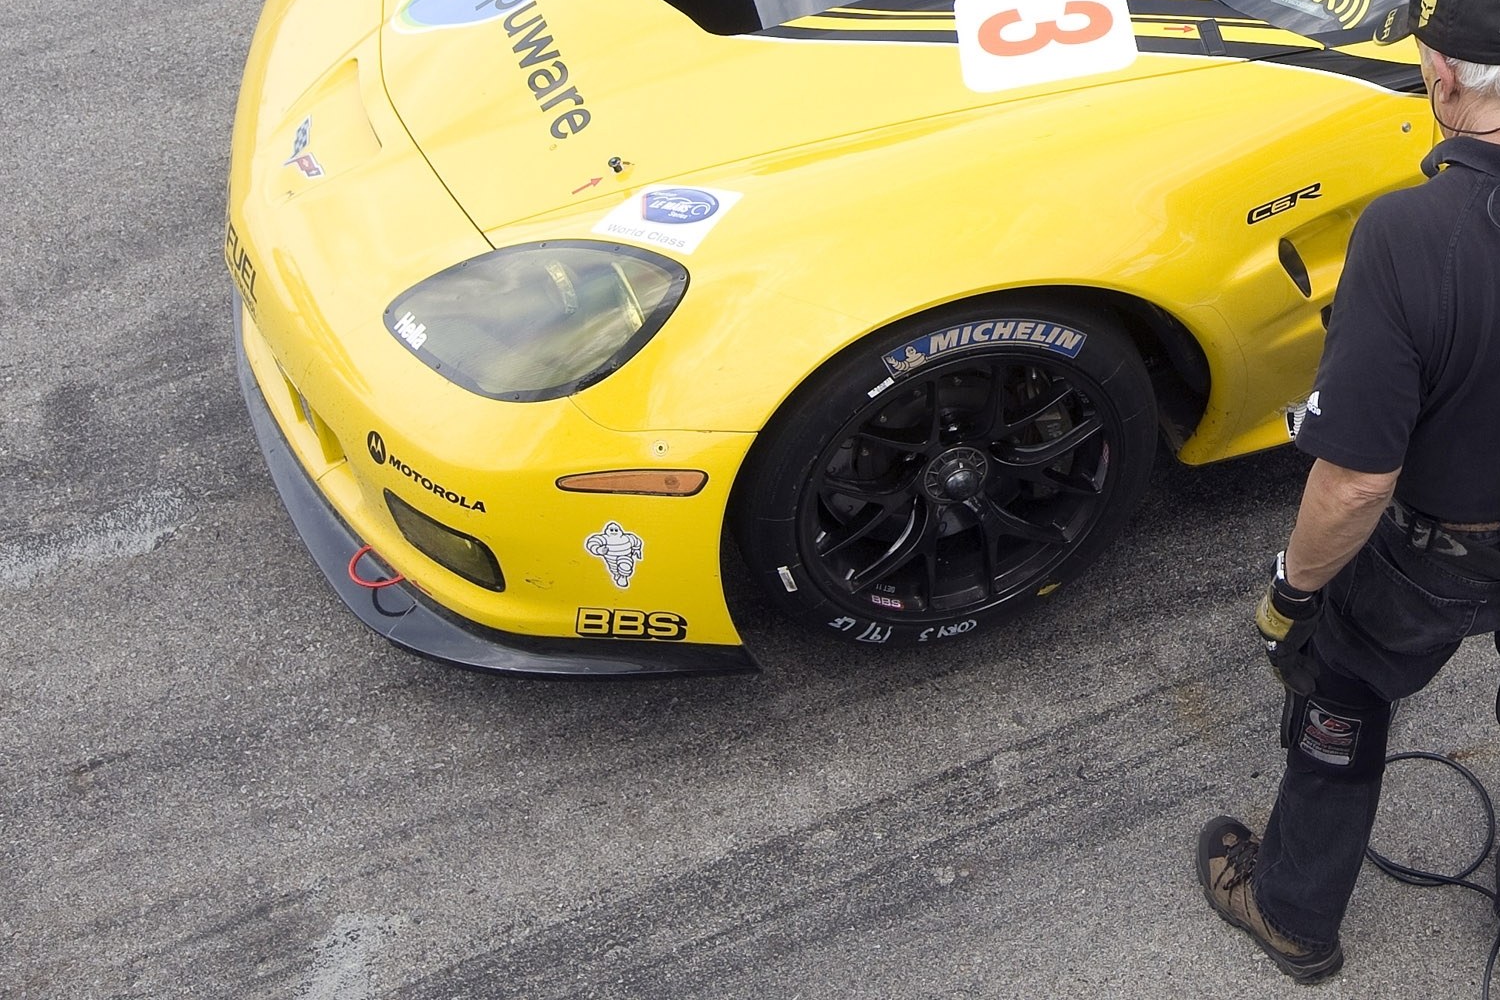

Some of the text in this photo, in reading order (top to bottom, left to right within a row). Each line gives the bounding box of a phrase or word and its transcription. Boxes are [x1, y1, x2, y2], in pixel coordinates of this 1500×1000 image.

[977, 0, 1114, 57] 3
[607, 223, 686, 248] World Class
[226, 221, 258, 304] FUEL
[394, 311, 429, 351] Hella
[929, 321, 1083, 355] MICHELIN
[388, 454, 487, 514] MOTOROLA
[871, 594, 902, 609] BBS
[576, 607, 688, 641] BBS
